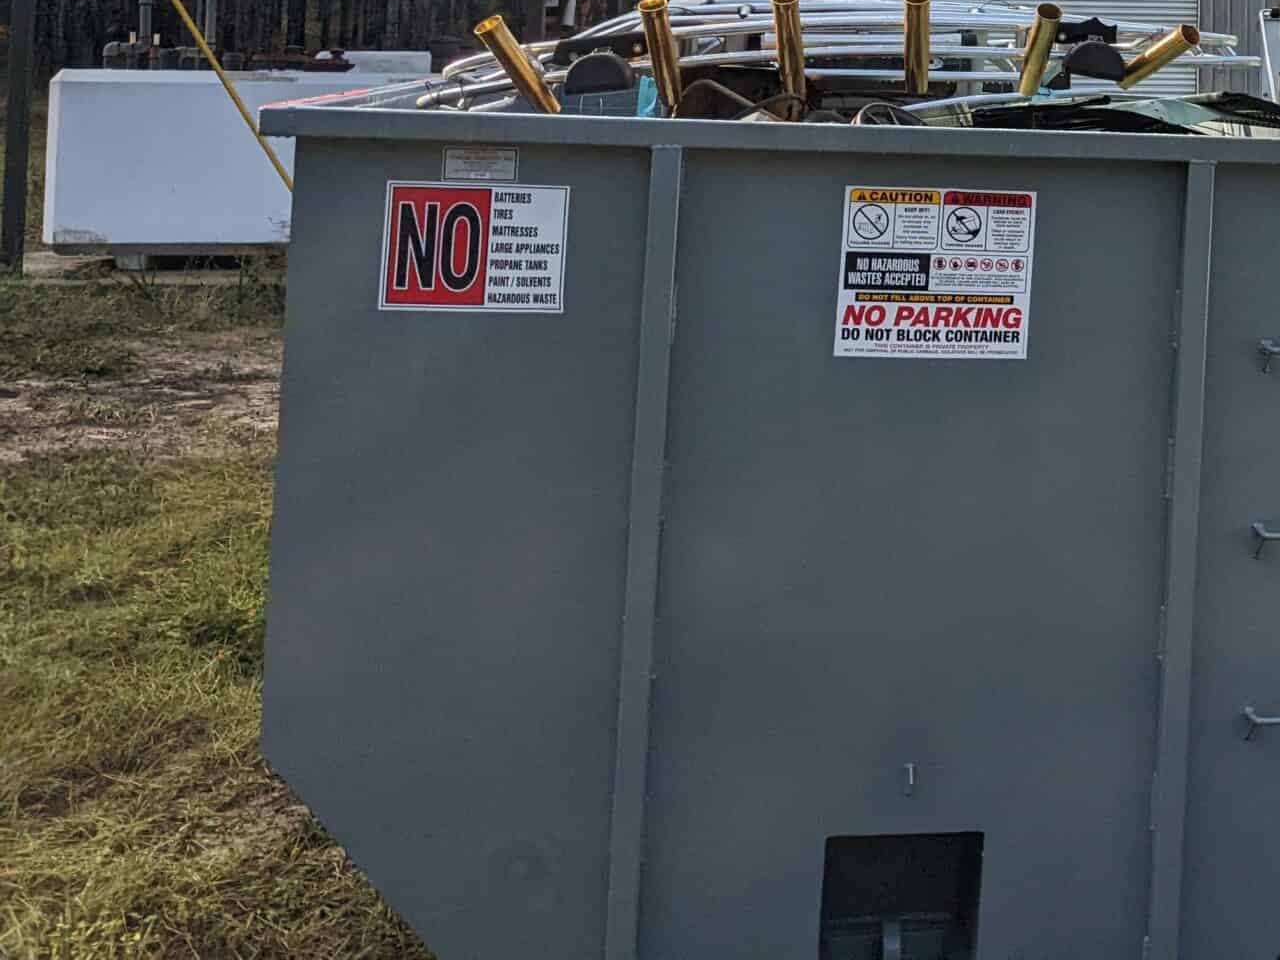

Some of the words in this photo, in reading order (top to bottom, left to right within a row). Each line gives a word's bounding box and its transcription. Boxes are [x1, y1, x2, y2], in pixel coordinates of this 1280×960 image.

[494, 192, 532, 204] BATTERIES
[870, 192, 934, 202] CAUTION
[494, 209, 513, 220] TIRES
[492, 226, 538, 238] MATTRESSES
[393, 201, 482, 292] NO
[490, 243, 513, 254] LARGE
[515, 244, 560, 254] APPLIANCES
[490, 259, 522, 270] PROPANE
[525, 260, 548, 270] TANKS
[856, 257, 870, 271] NO
[872, 258, 920, 272] HAZARDOUS
[488, 276, 510, 287] PAINT
[516, 276, 552, 288] SOLVENTS
[848, 272, 882, 285] WASTES
[884, 272, 926, 286] ACCEPTED
[487, 293, 530, 304] HAZARDOUS
[532, 294, 557, 304] WASTE
[842, 304, 886, 326] NO
[893, 306, 1022, 328] PARKING
[841, 328, 860, 340] DO
[864, 328, 892, 341] NOT
[896, 329, 941, 342] BLOCK
[945, 330, 1020, 343] CONTAINER
